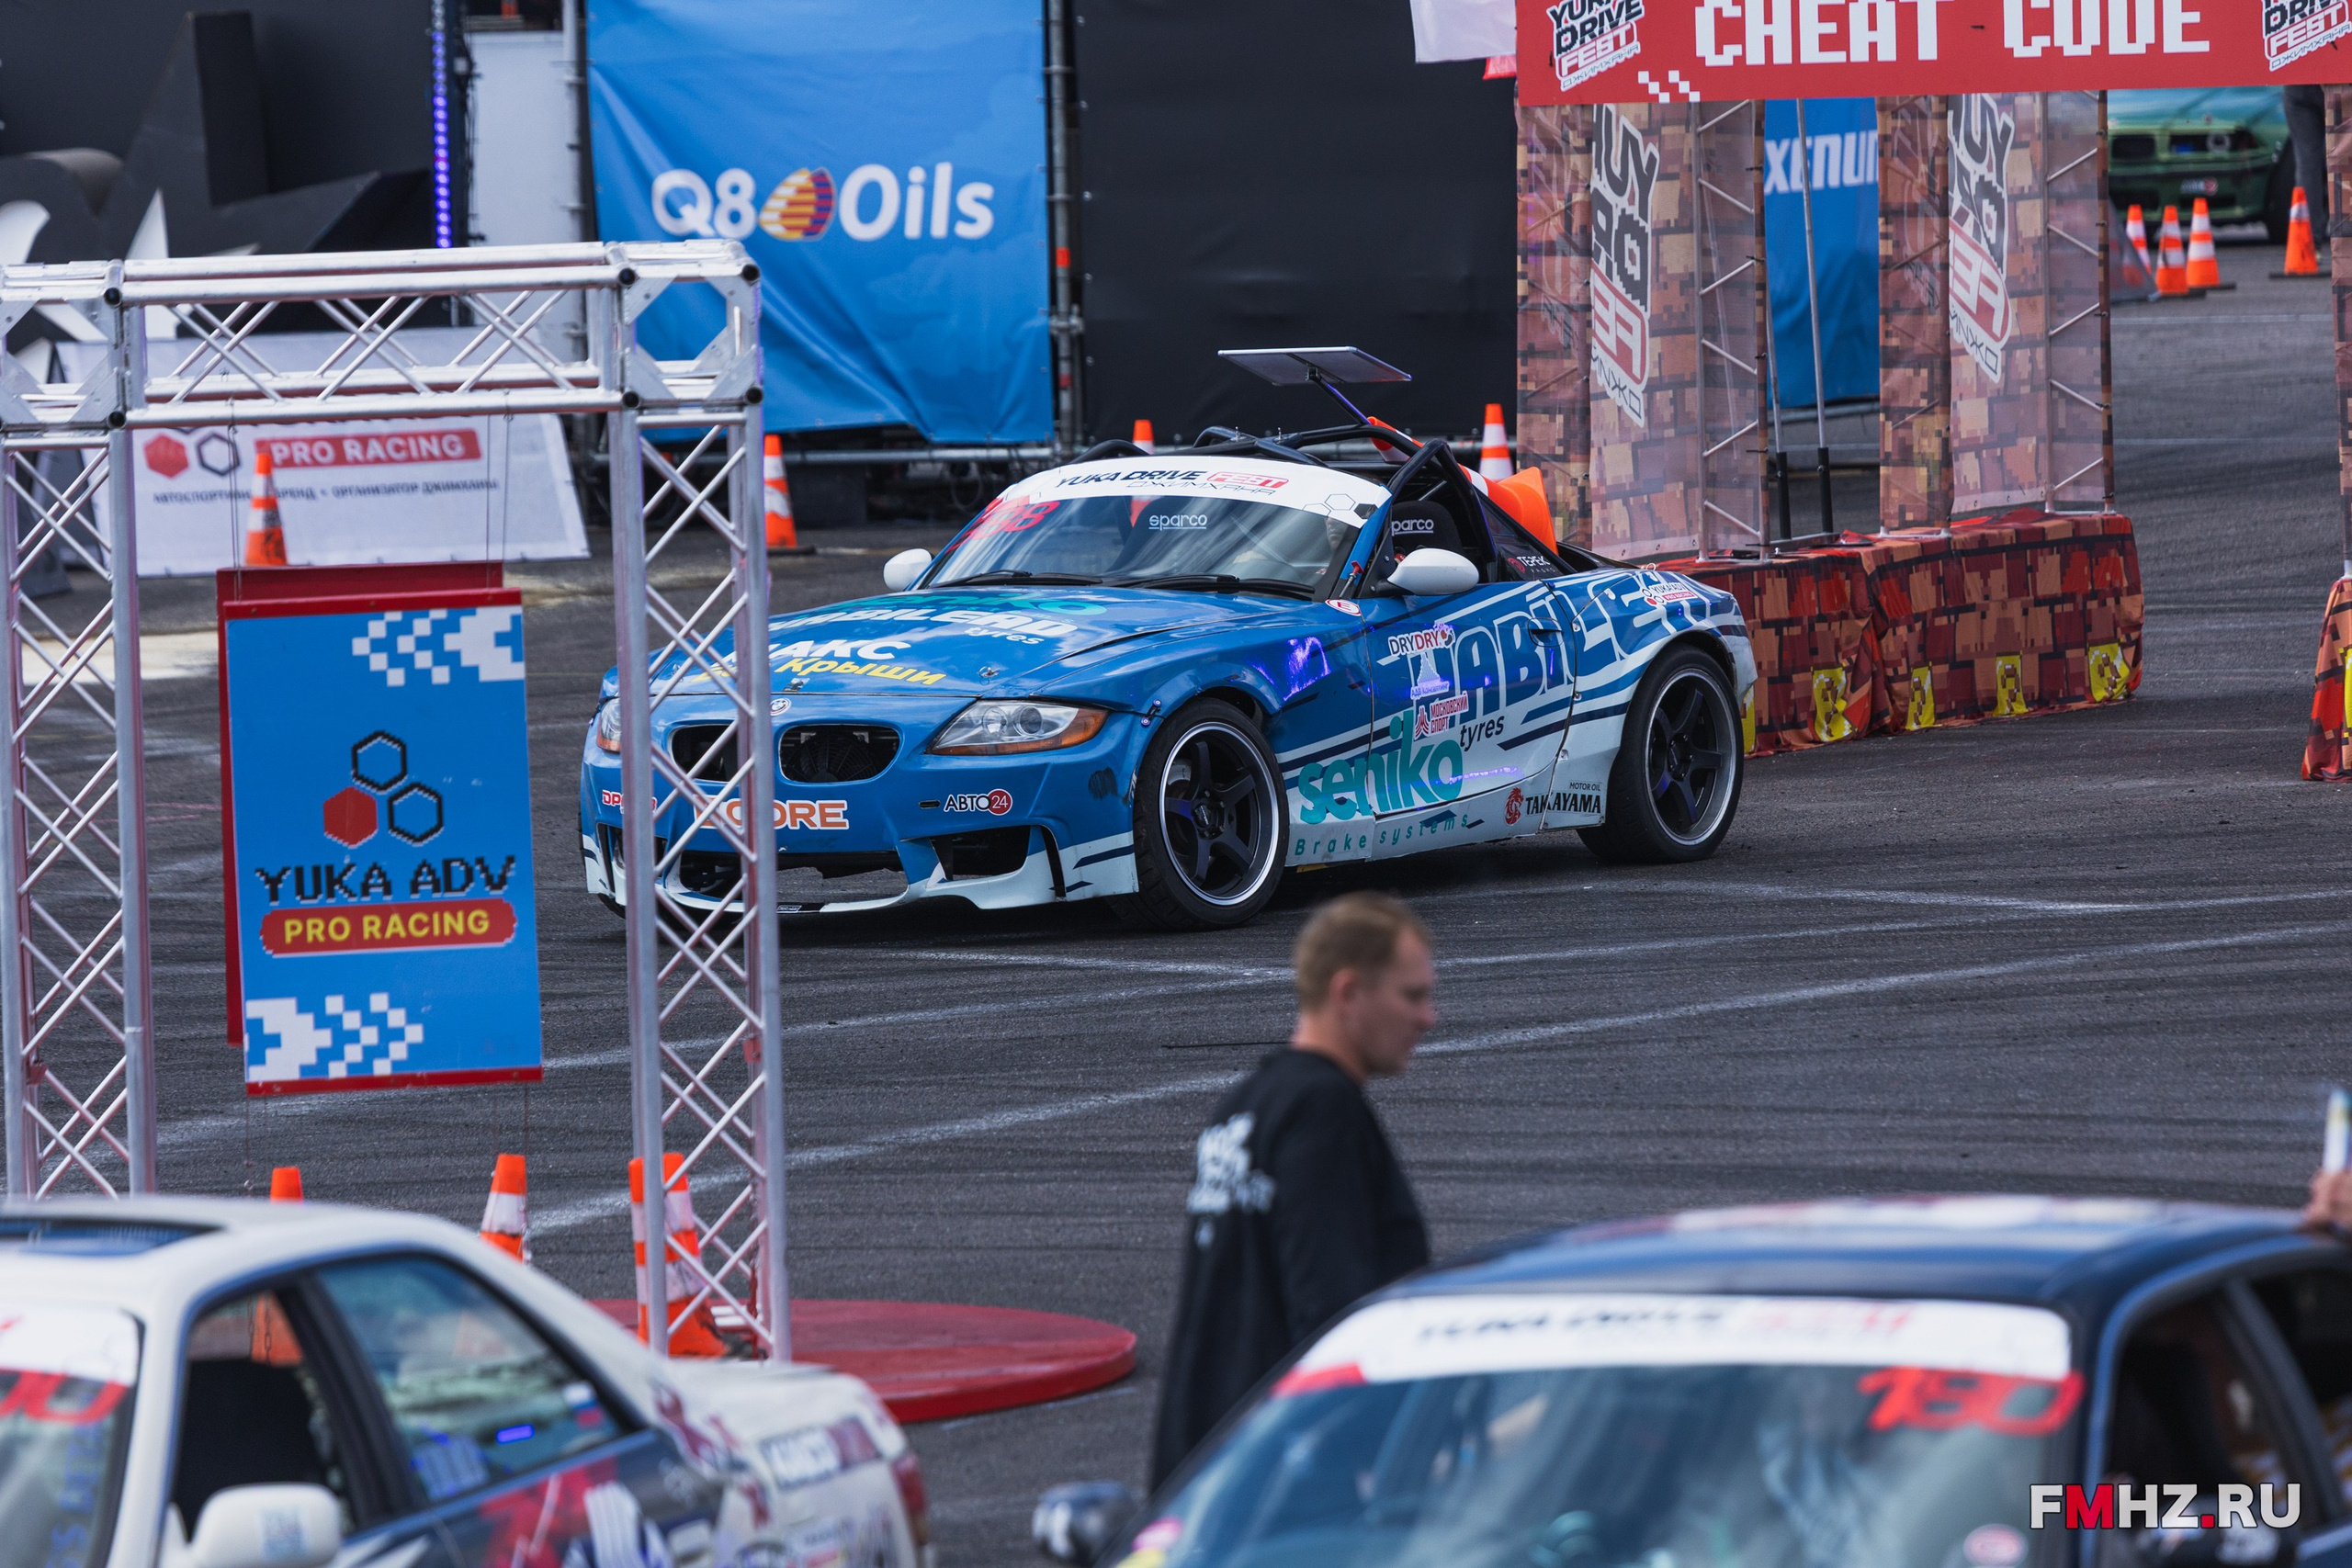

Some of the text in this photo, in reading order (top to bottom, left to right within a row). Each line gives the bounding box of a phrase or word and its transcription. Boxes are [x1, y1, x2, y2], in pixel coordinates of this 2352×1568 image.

[1550, 0, 1611, 29] YUK
[1555, 0, 1643, 56] DRIVE
[2270, 2, 2343, 56] FEST
[1694, 0, 2210, 66] CHEAT CODE
[1561, 21, 1631, 77] FEST
[651, 162, 994, 242] Q8 Oils
[269, 433, 466, 465] PRO RACING
[1055, 470, 1287, 489] YUKA DRIVE FEST
[1148, 514, 1208, 530] sparco
[1391, 519, 1434, 536] parco
[966, 626, 1046, 645] tyres
[1389, 629, 1441, 655] DRYDRY
[775, 658, 946, 686] Крыши
[1430, 692, 1468, 718] МОСКОВСКИЙ
[1430, 716, 1449, 734] СПОРТ
[1459, 716, 1505, 752] tyres
[1298, 709, 1463, 824] seniko
[1569, 782, 1600, 791] MOTOR OIL
[1525, 792, 1601, 816] TAKAYAMA
[1295, 814, 1469, 856] Brake systems
[254, 854, 515, 906] YUKA ADV
[284, 909, 491, 944] PRO RACING
